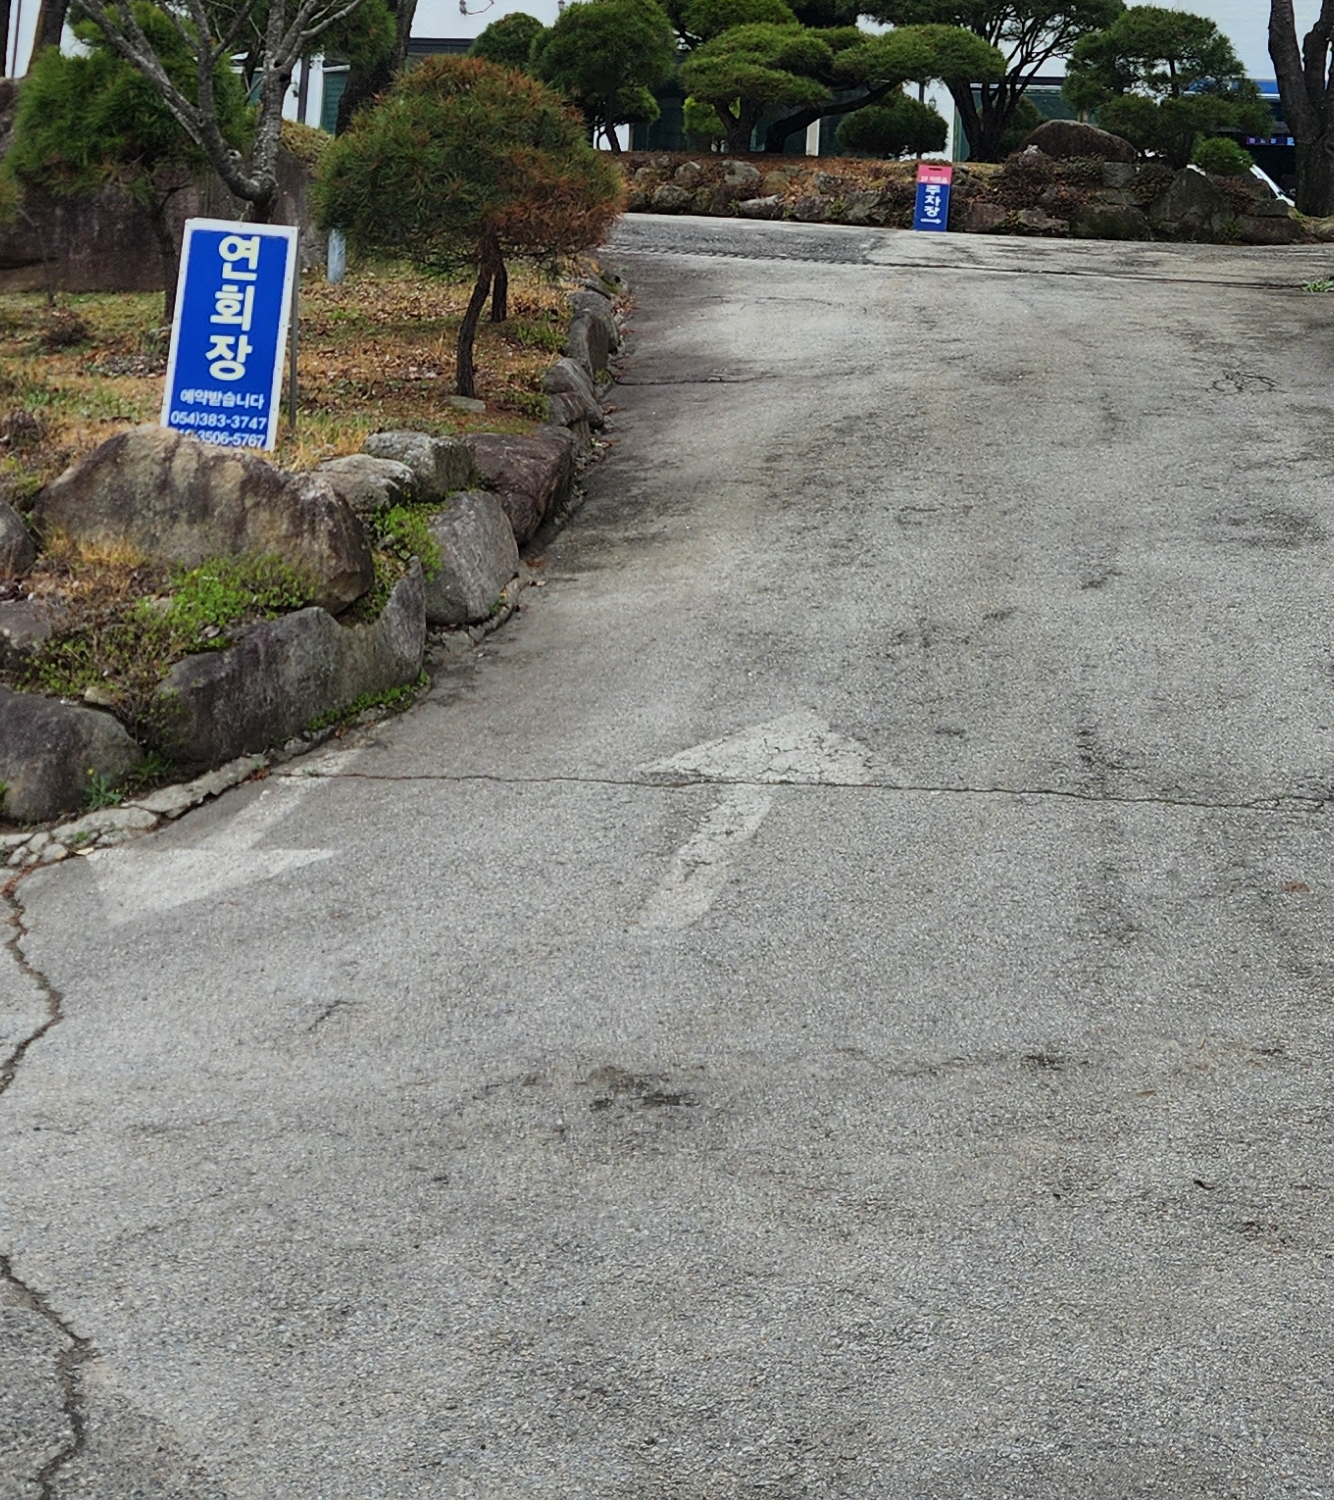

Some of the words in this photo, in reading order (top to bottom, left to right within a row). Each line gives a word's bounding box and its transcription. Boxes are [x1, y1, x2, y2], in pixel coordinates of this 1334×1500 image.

[923, 184, 942, 218] 주차장
[205, 234, 261, 382] 연회장
[180, 388, 265, 410] 예약받습니다
[170, 410, 267, 431] 054)383-3747
